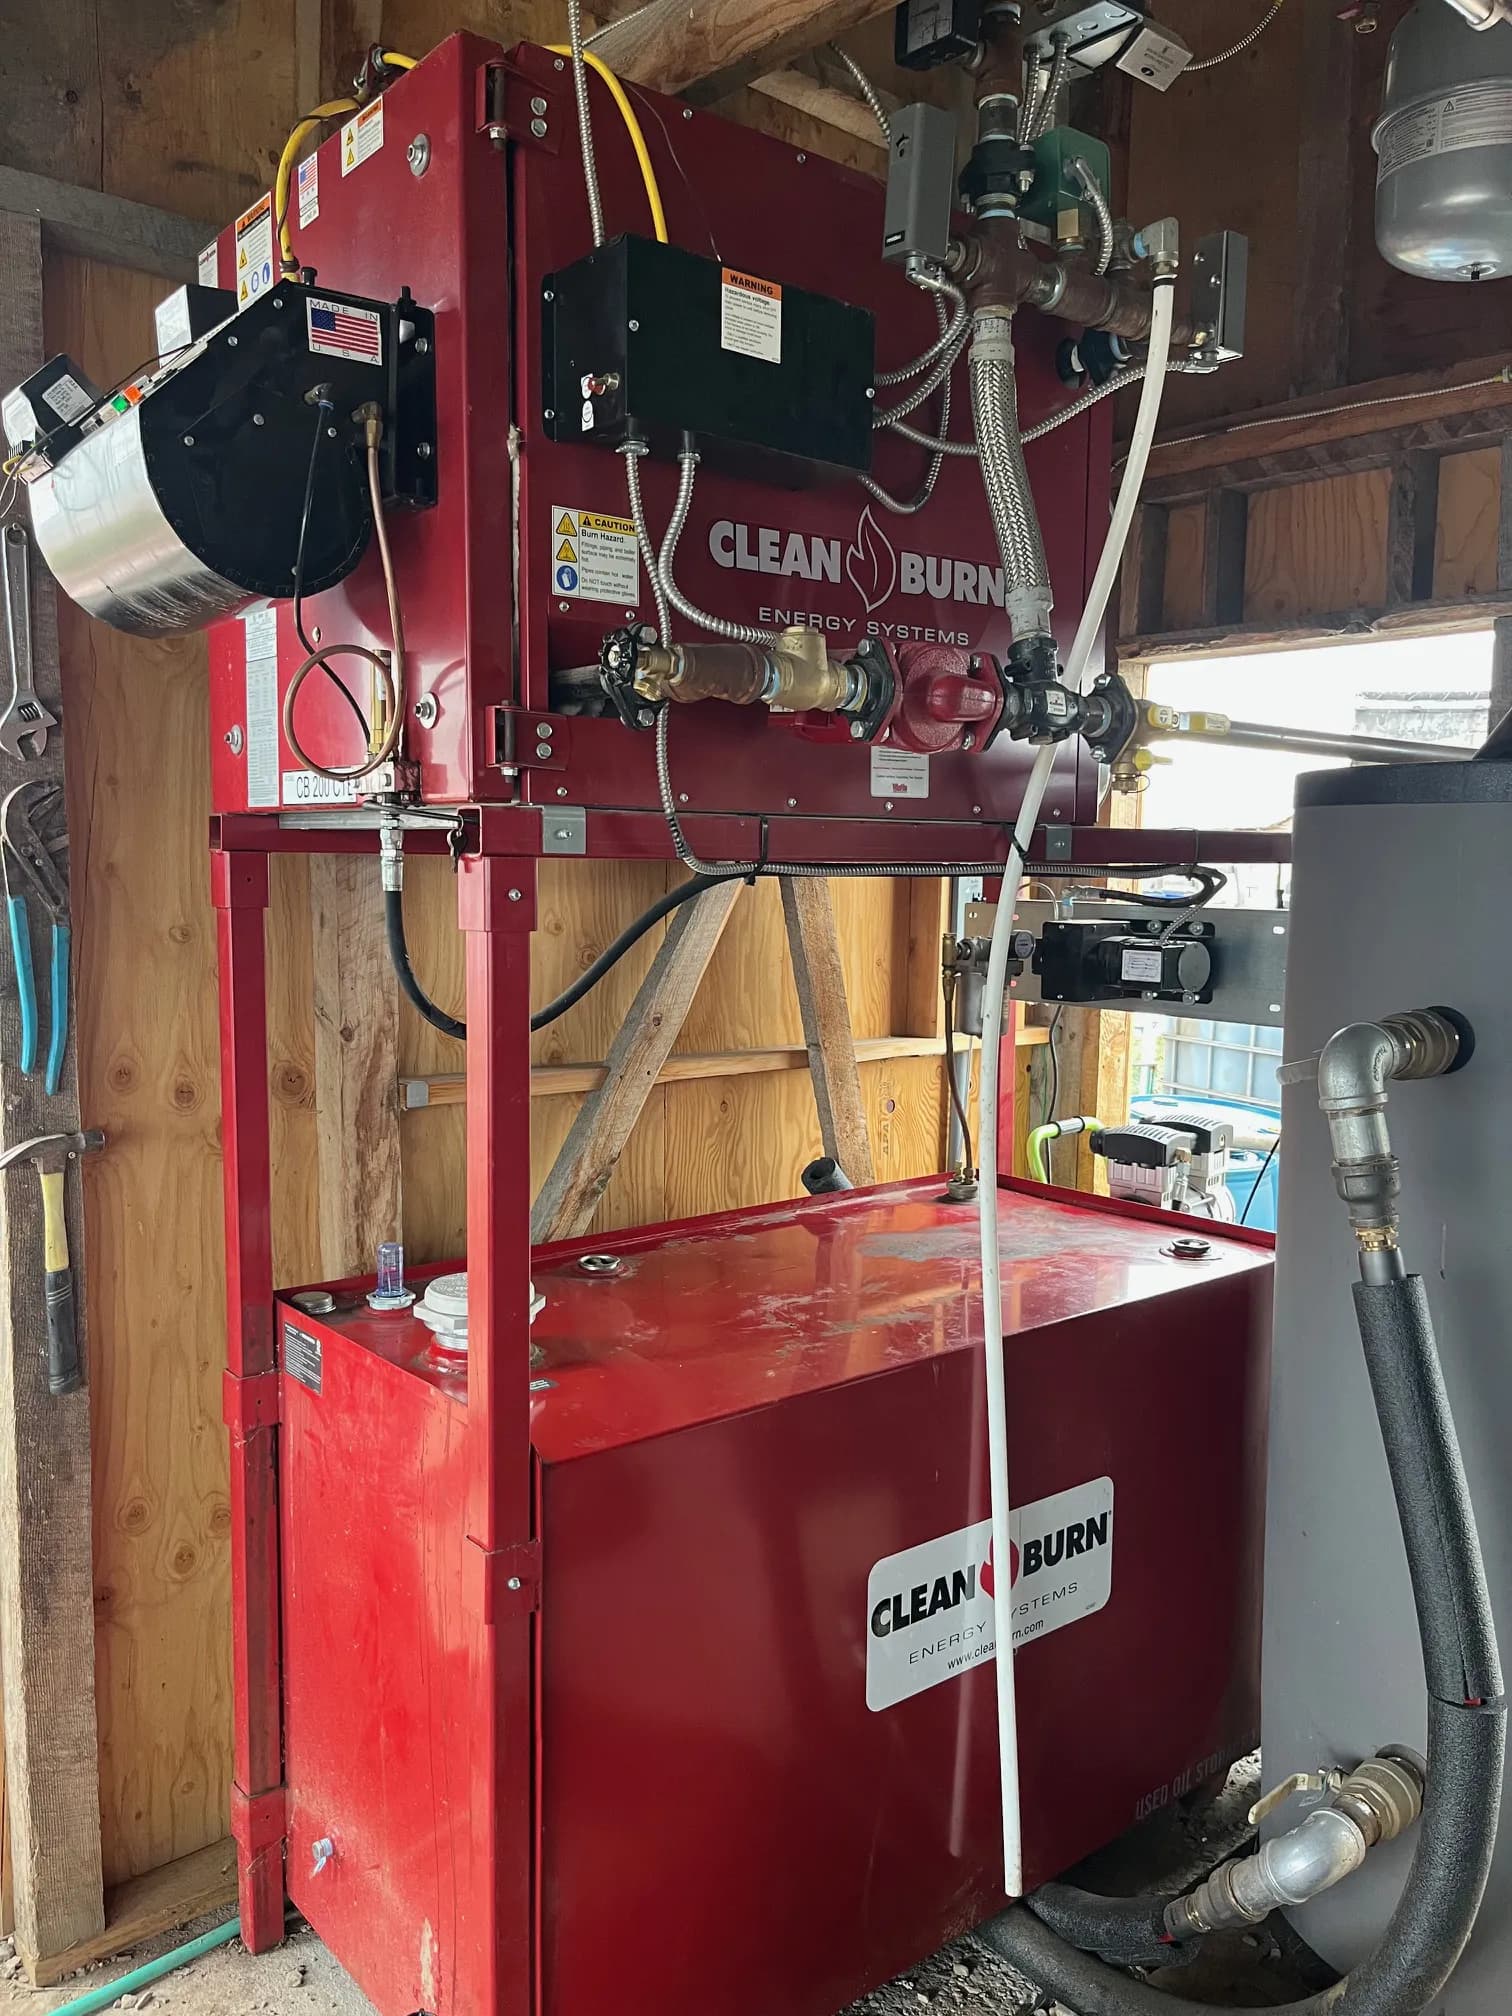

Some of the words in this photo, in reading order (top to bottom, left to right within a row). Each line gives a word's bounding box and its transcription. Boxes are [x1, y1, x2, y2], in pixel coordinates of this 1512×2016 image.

[730, 274, 773, 294] WARNING
[310, 300, 349, 314] MADE
[365, 312, 378, 322] IN
[581, 529, 599, 540] Burn
[600, 533, 624, 544] Hazard
[595, 519, 635, 532] CAUTION
[709, 520, 841, 584] CLEAN
[900, 551, 1005, 607] BURN
[758, 606, 856, 632] ENERGY
[866, 621, 969, 646] SYSTEMS
[296, 776, 310, 798] CB
[871, 1564, 976, 1638] CLEAN
[1023, 1511, 1108, 1578] BURN
[909, 1621, 987, 1665] ENERGY
[1135, 1783, 1169, 1820] USED
[1172, 1767, 1192, 1797] OIL
